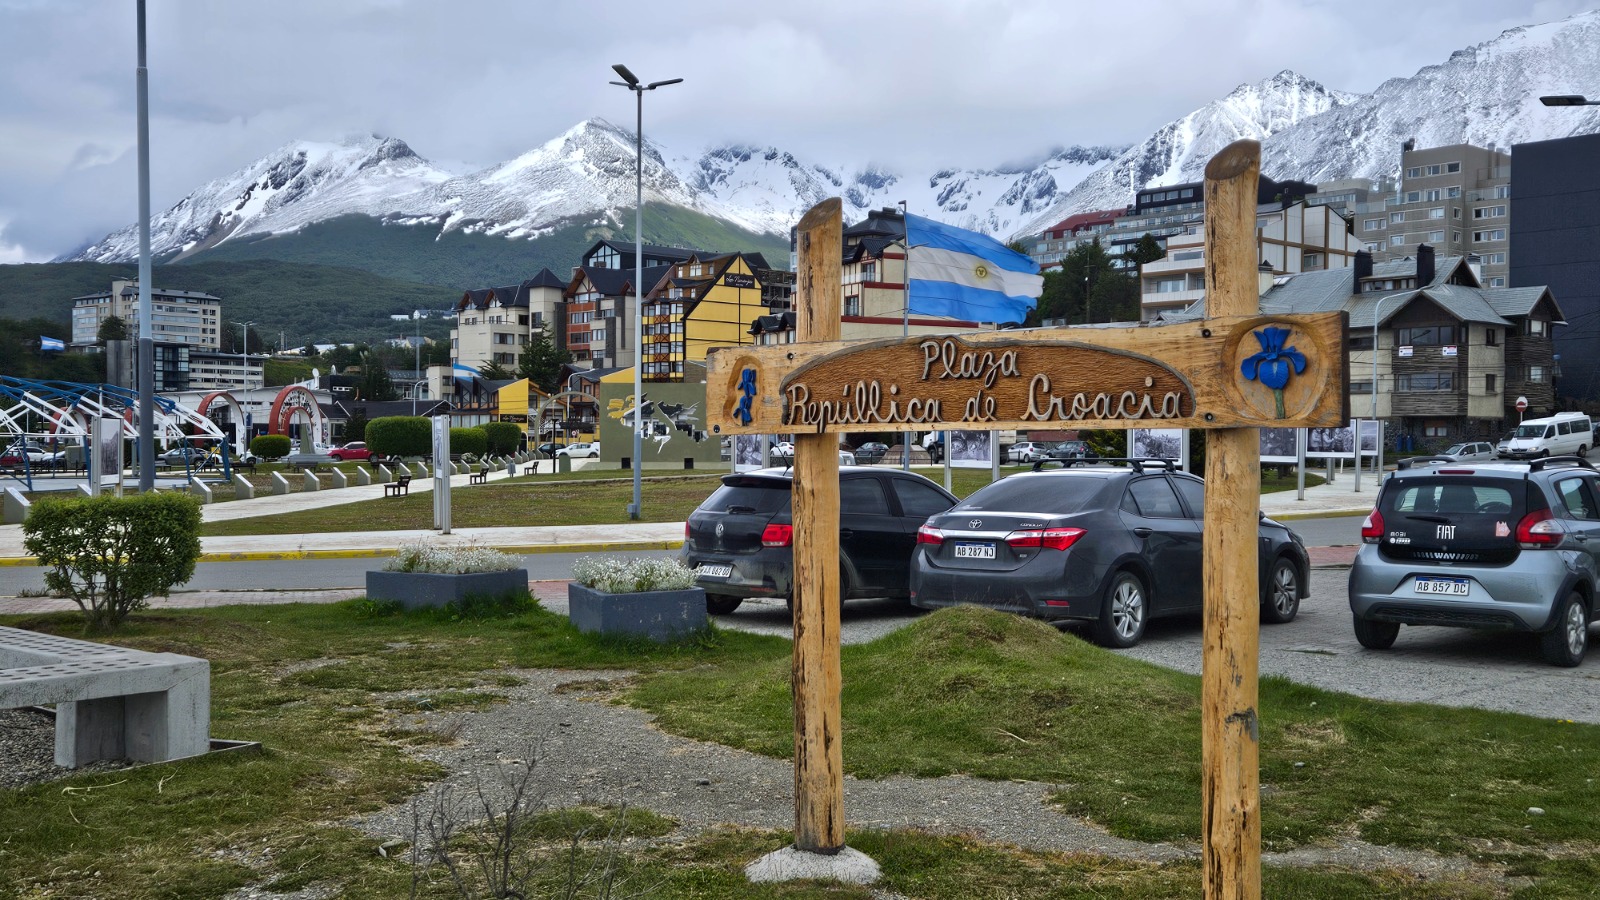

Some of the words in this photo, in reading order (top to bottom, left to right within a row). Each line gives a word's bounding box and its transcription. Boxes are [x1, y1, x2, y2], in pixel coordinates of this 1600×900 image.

[920, 340, 1021, 388] Plaza
[787, 380, 944, 432] República
[961, 389, 998, 423] de
[1019, 373, 1184, 422] Croacia
[1436, 524, 1457, 540] FIAT
[956, 548, 966, 557] AB
[968, 547, 982, 557] 287
[984, 548, 994, 558] NJ
[1417, 581, 1430, 592] AB
[1432, 582, 1451, 593] 857
[1453, 583, 1466, 594] DC
